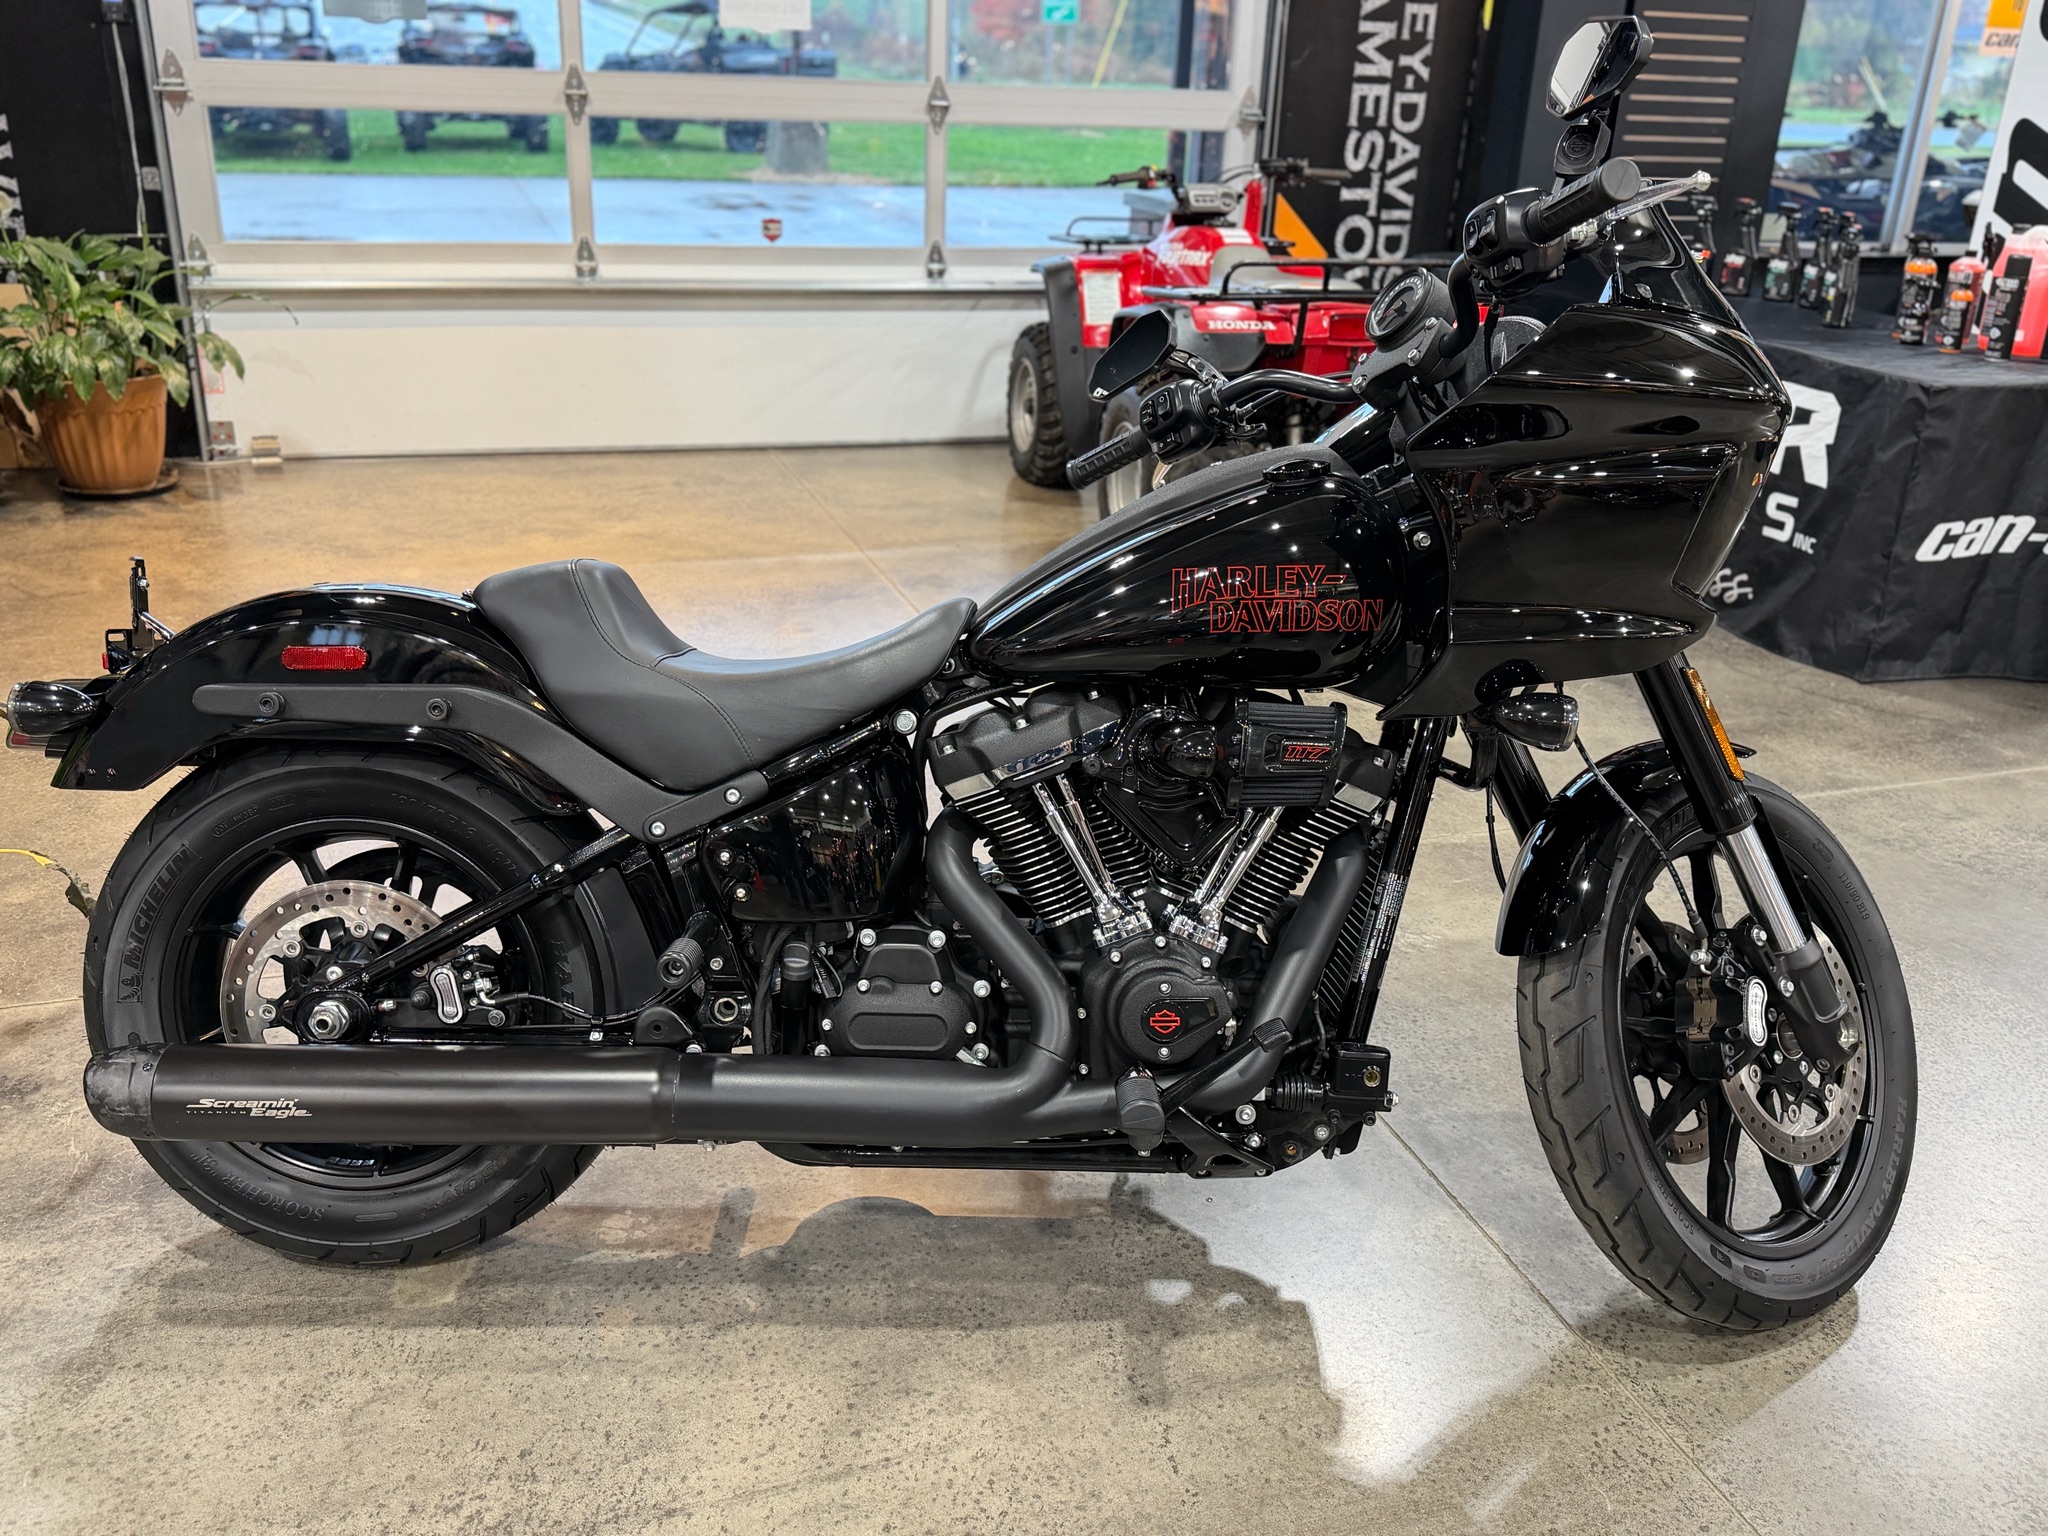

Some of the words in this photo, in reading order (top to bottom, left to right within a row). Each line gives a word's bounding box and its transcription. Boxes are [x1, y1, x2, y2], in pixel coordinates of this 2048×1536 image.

[1208, 319, 1277, 331] HONDA
[1791, 531, 1817, 555] INC
[1915, 514, 2048, 562] can-
[1171, 564, 1347, 614] HARLEY-
[1209, 599, 1384, 633] DAVIDSON
[1284, 745, 1331, 759] 117
[123, 845, 193, 970] MICHELIN
[249, 1107, 313, 1119] Eagle
[221, 1171, 325, 1222] SCORCHER
